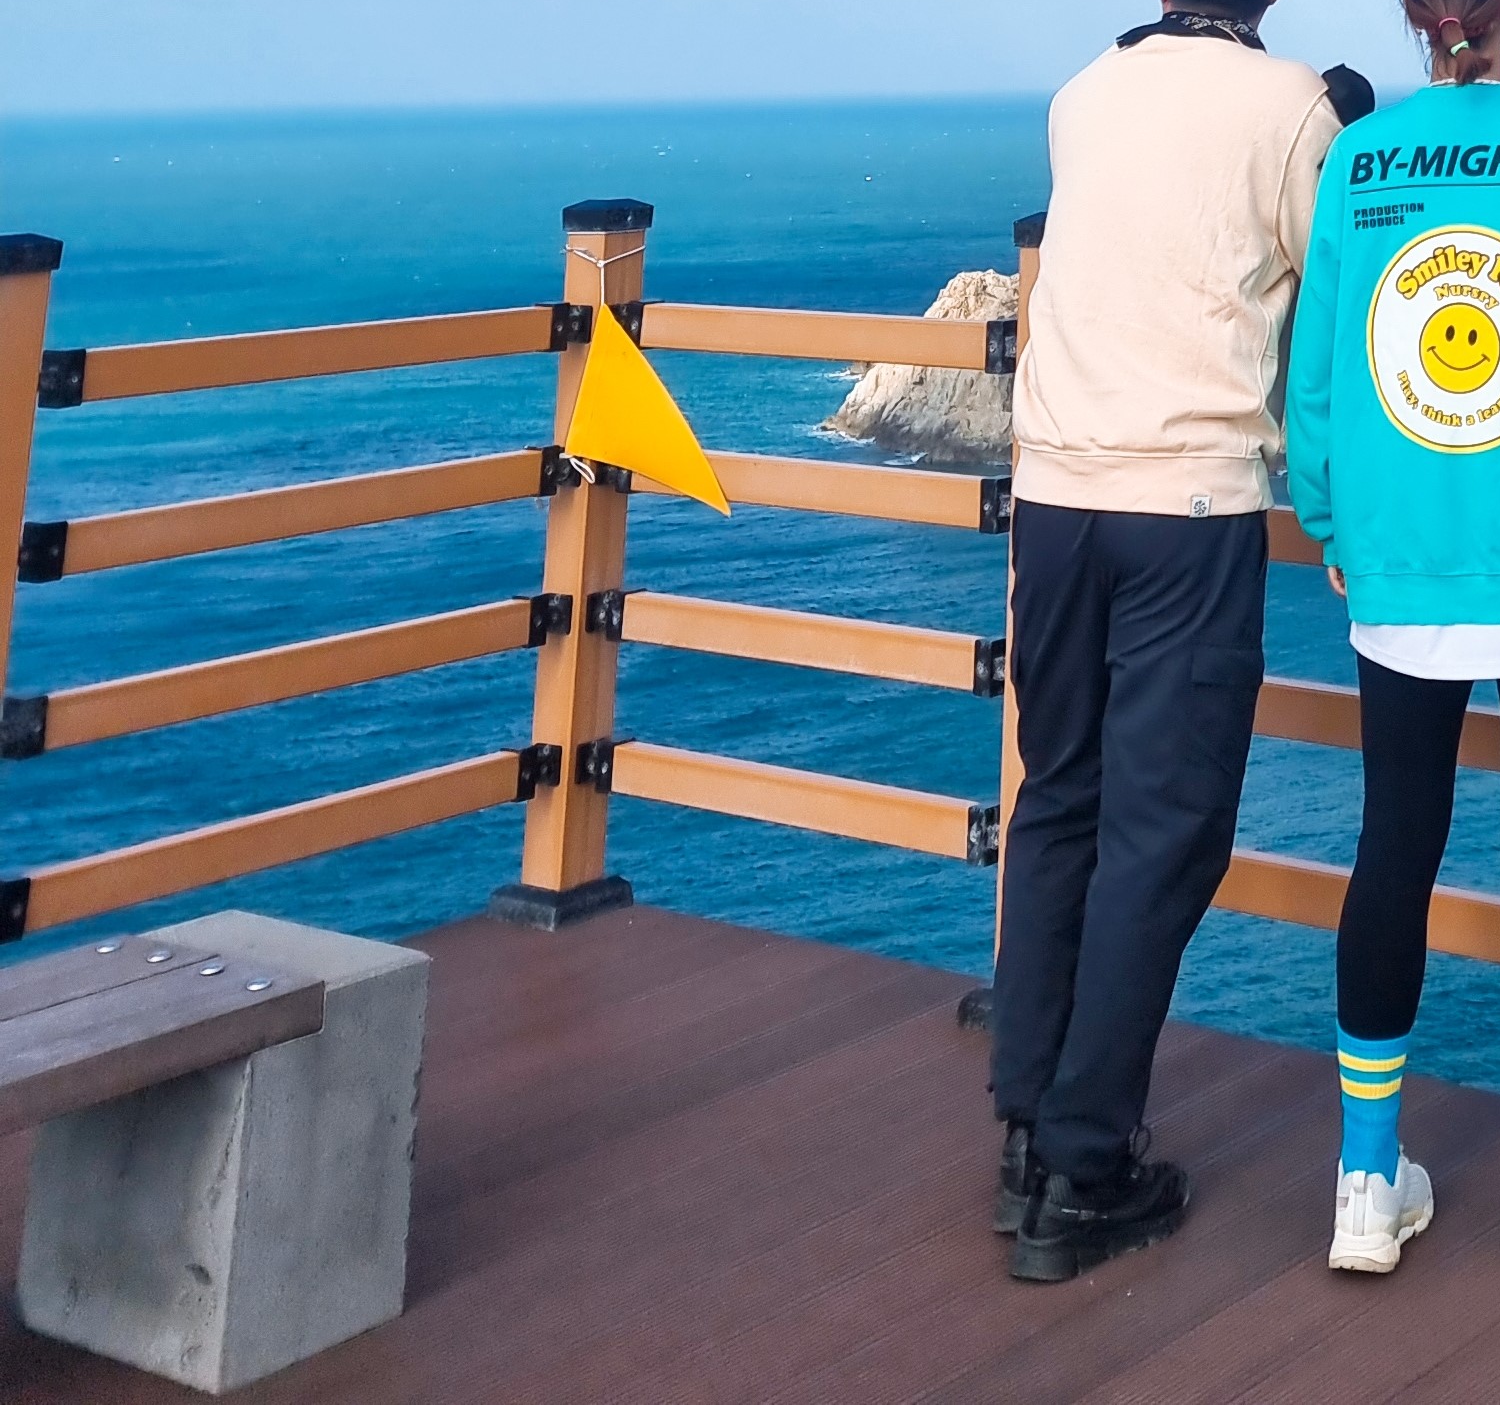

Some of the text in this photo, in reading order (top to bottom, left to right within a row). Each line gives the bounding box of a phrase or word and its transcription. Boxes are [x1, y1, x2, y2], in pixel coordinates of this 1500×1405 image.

[1354, 202, 1425, 219] PRODUCTION
[1355, 215, 1405, 230] PRODUCE
[1396, 244, 1490, 300] Smiley
[1421, 404, 1462, 427] think
